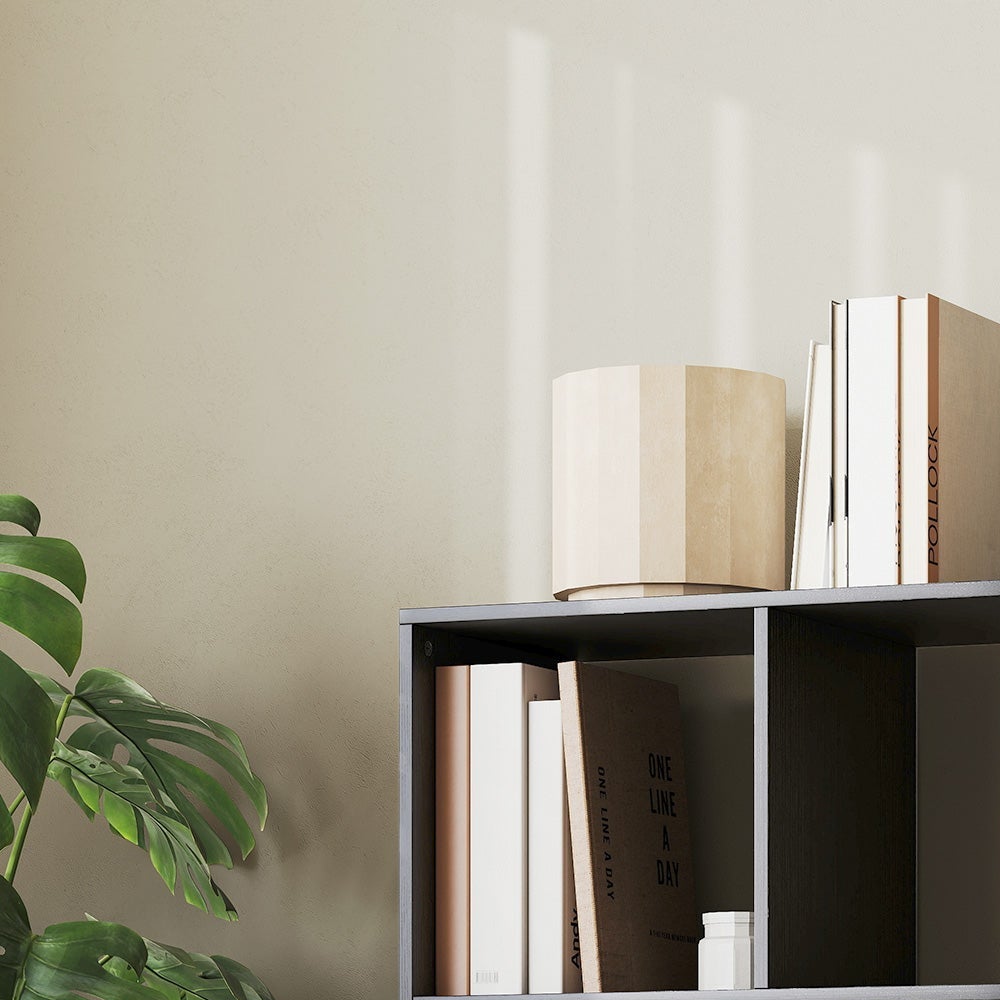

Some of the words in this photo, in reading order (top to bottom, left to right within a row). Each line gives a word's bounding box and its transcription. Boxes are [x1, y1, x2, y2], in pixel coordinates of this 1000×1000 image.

[927, 425, 938, 566] POLLOCK
[647, 752, 673, 782] ONE
[597, 767, 608, 799] ONE
[649, 787, 678, 818] LINE
[599, 807, 611, 846] LINE
[662, 825, 671, 851] A
[604, 851, 613, 863] A
[605, 869, 616, 901] DAY
[656, 858, 680, 888] DAY
